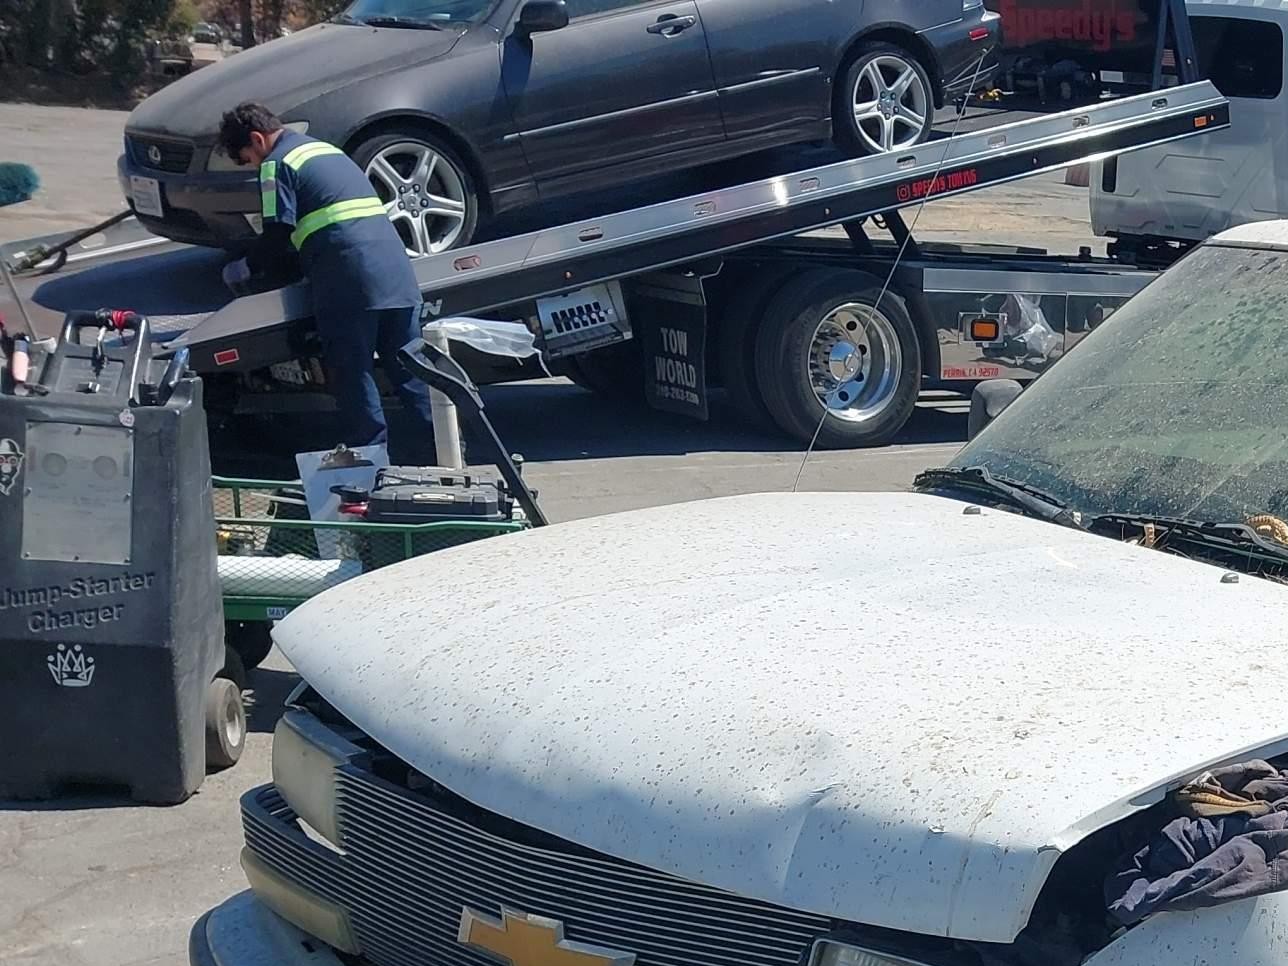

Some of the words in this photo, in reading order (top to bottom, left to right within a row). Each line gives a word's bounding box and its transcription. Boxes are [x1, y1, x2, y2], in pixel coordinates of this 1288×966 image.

[660, 327, 687, 357] TOW
[656, 356, 696, 388] WORLD
[0, 572, 156, 609] Jump-Starter
[28, 604, 125, 633] Charger
